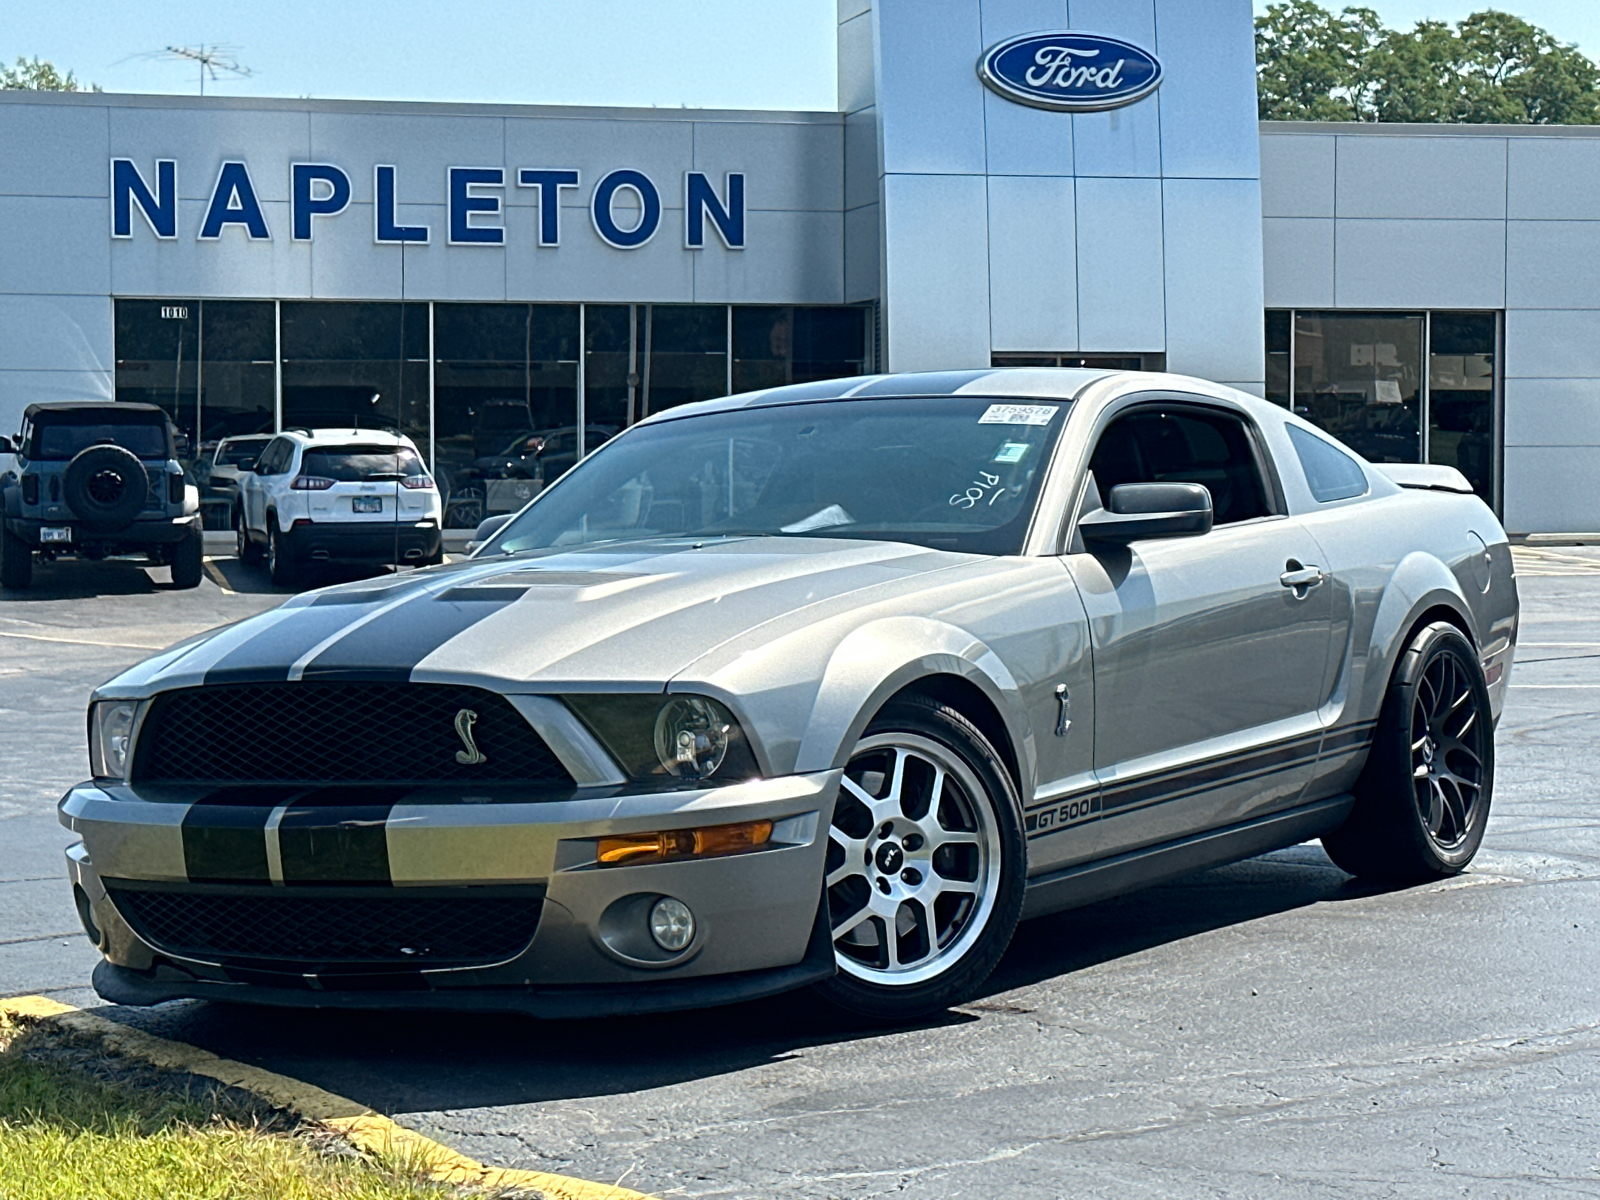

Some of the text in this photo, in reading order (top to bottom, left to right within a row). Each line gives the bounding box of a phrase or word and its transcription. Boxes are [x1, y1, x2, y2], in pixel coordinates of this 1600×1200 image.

[1025, 46, 1125, 89] Ford
[110, 157, 746, 250] NAPLETON
[162, 306, 187, 319] 1010
[990, 405, 1053, 415] 3759578
[1038, 799, 1090, 828] GT 500
